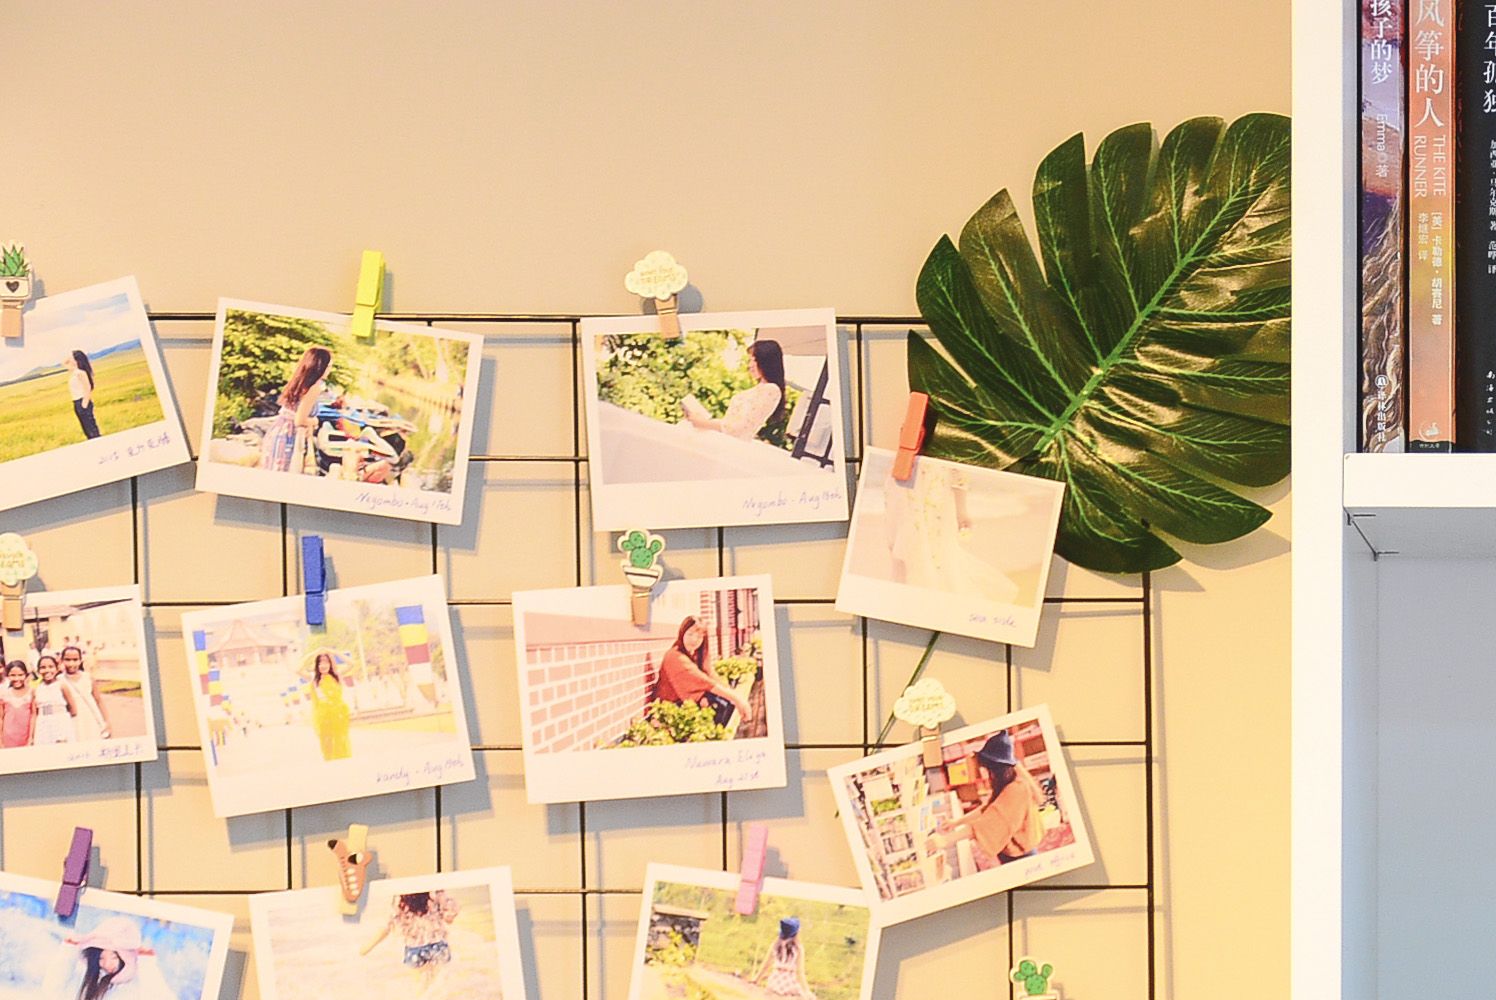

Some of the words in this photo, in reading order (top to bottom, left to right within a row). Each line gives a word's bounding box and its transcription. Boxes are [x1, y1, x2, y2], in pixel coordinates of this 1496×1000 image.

[1414, 0, 1445, 128] 风筝的人
[1376, 114, 1387, 151] Emma
[1433, 135, 1447, 164] THE
[1413, 135, 1427, 198] RUNNER
[1433, 169, 1447, 196] KITE
[1376, 389, 1387, 443] 译林出版社
